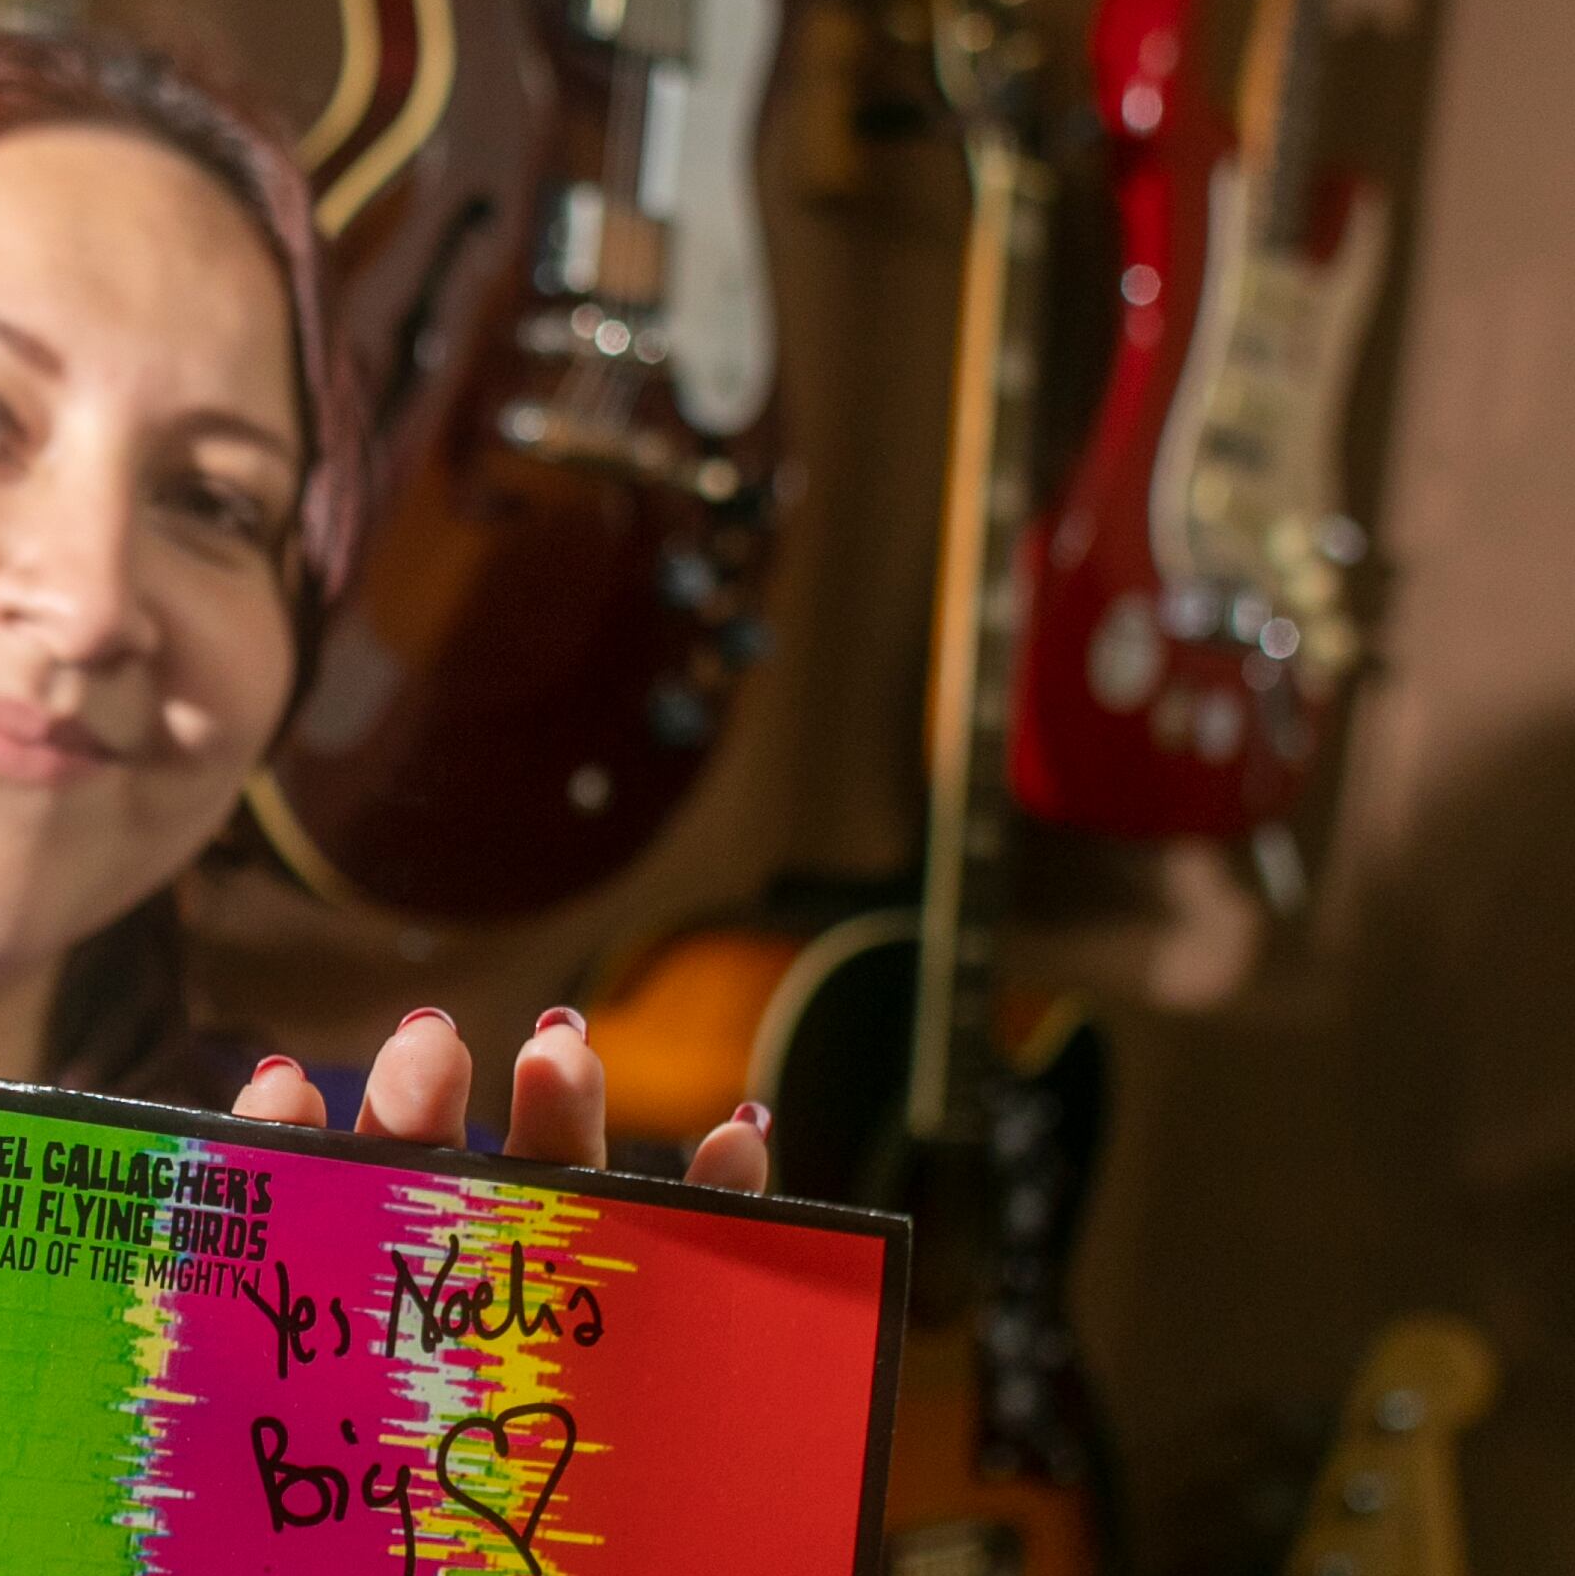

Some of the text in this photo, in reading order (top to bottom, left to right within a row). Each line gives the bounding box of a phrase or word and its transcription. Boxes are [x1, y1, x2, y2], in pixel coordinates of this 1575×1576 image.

[42, 1141, 273, 1215] GALLAGHER'S
[35, 1190, 155, 1247] FLYING
[169, 1208, 268, 1262] BIRDS
[45, 1241, 81, 1277] OF
[89, 1245, 138, 1286] THE
[144, 1253, 246, 1299] MIGHTY
[241, 1261, 351, 1379] Yes
